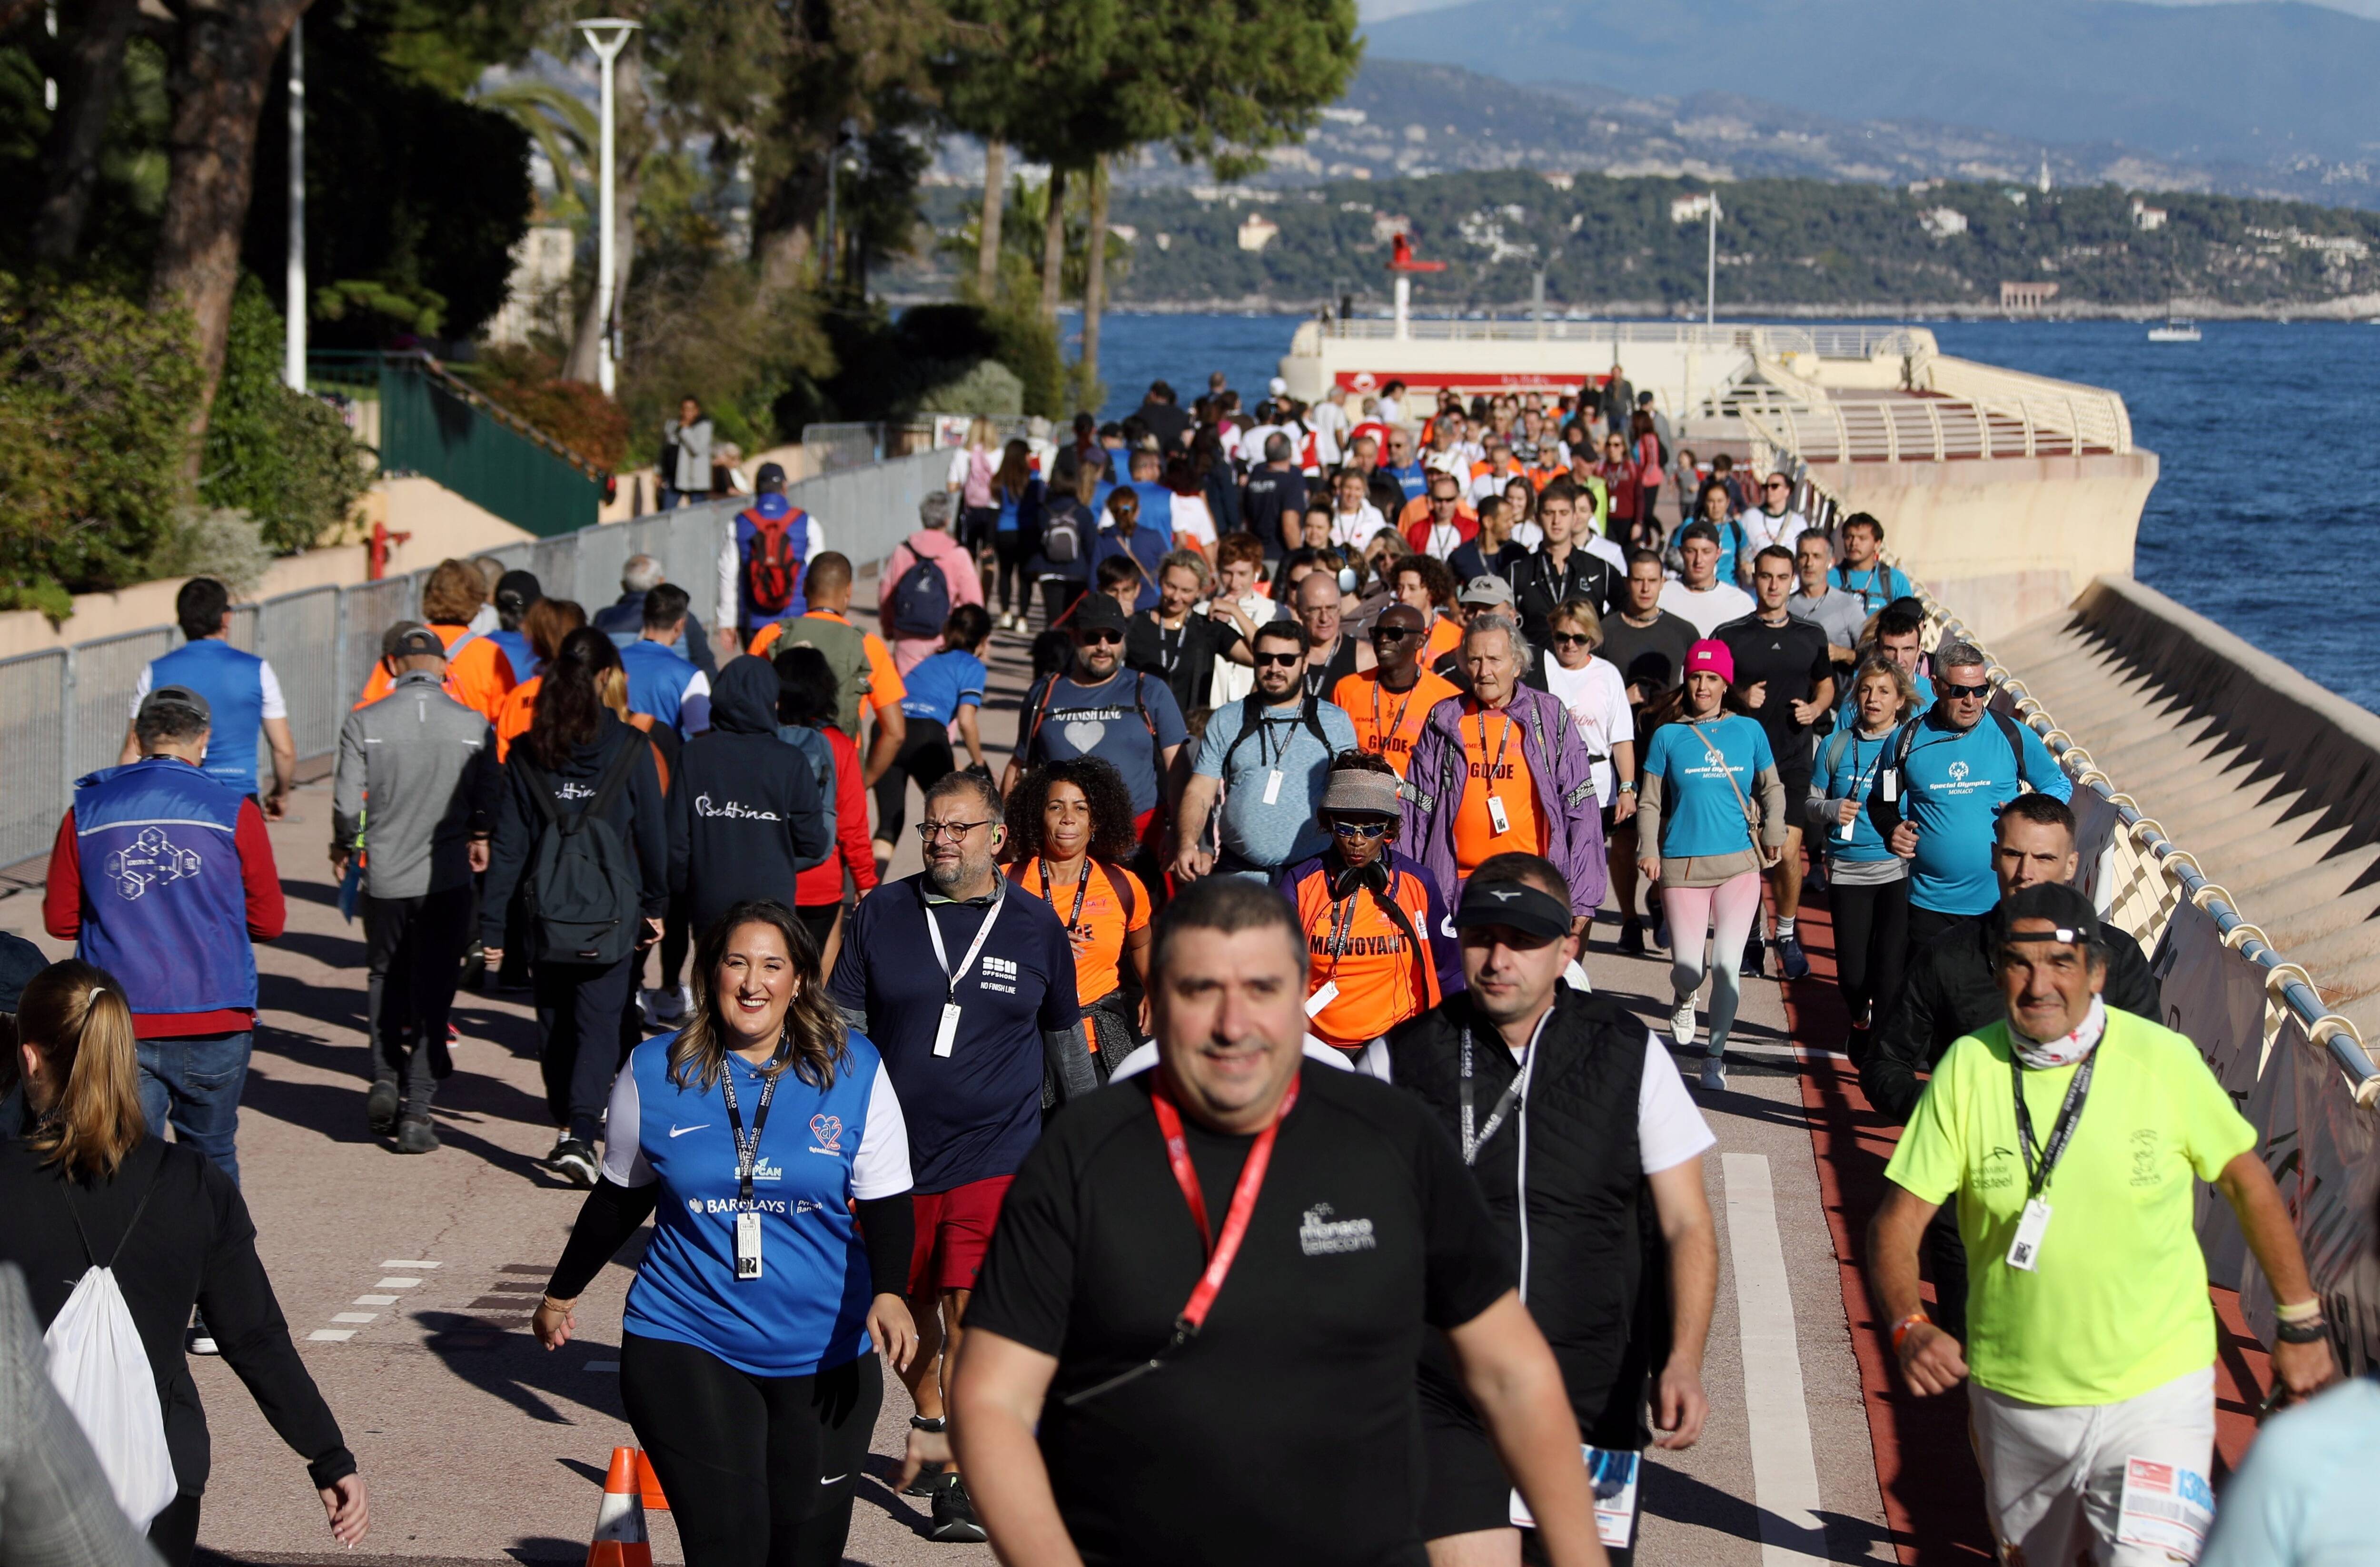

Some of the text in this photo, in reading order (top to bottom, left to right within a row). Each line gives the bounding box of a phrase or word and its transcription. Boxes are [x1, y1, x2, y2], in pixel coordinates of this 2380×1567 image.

[1957, 780, 1991, 788] Olympics
[695, 791, 782, 821] Bettina
[982, 970, 1016, 981] OFFSHORE
[989, 983, 1005, 992] FINISH
[1005, 986, 1016, 994] LINE
[722, 1059, 737, 1109] MONTE-CARLO
[743, 1127, 758, 1176] MONTE-CARLO
[1300, 1218, 1373, 1240] monaco
[1301, 1234, 1377, 1256] telecom
